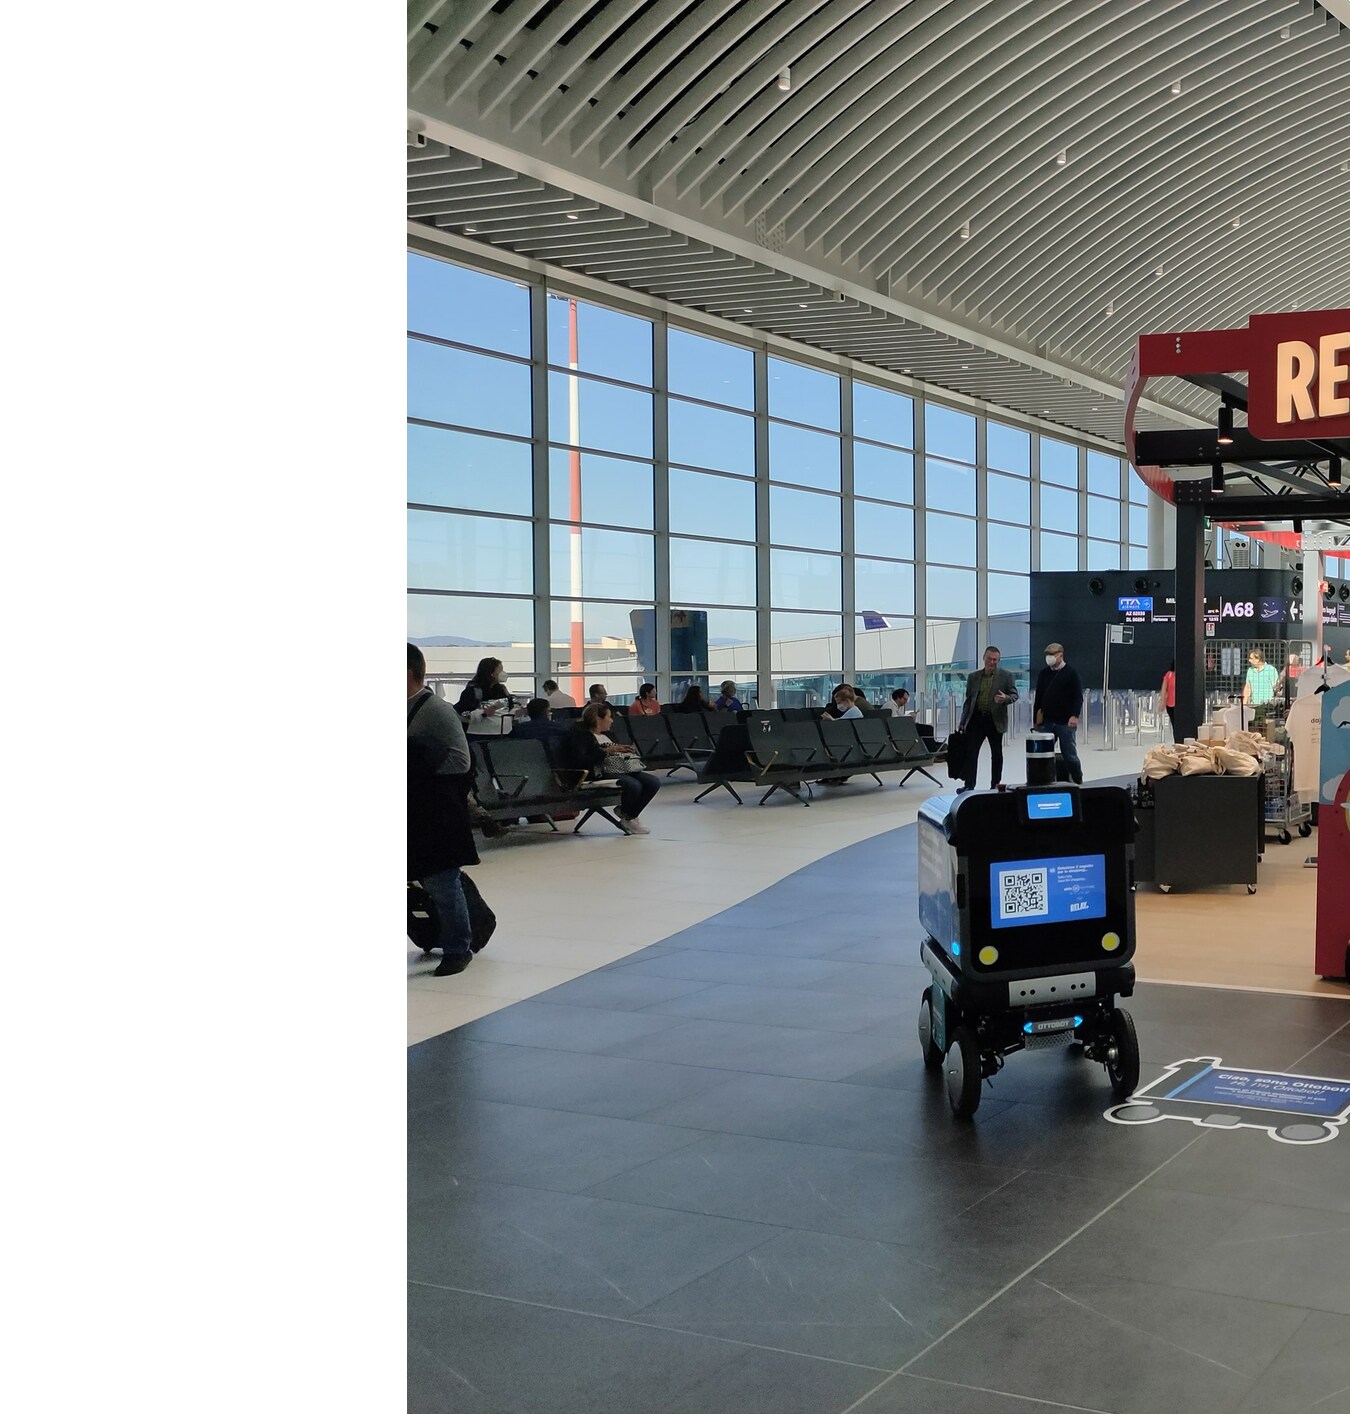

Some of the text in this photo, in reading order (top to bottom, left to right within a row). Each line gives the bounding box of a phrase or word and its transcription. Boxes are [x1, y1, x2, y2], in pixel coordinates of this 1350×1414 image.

[1222, 602, 1254, 617] A68
[1037, 1020, 1070, 1030] OTTOBOT
[1218, 1073, 1251, 1083] Ciao,
[1254, 1077, 1288, 1087] sono
[1292, 1080, 1350, 1094] Ottobot!
[1273, 1084, 1326, 1096] Ottobot!
